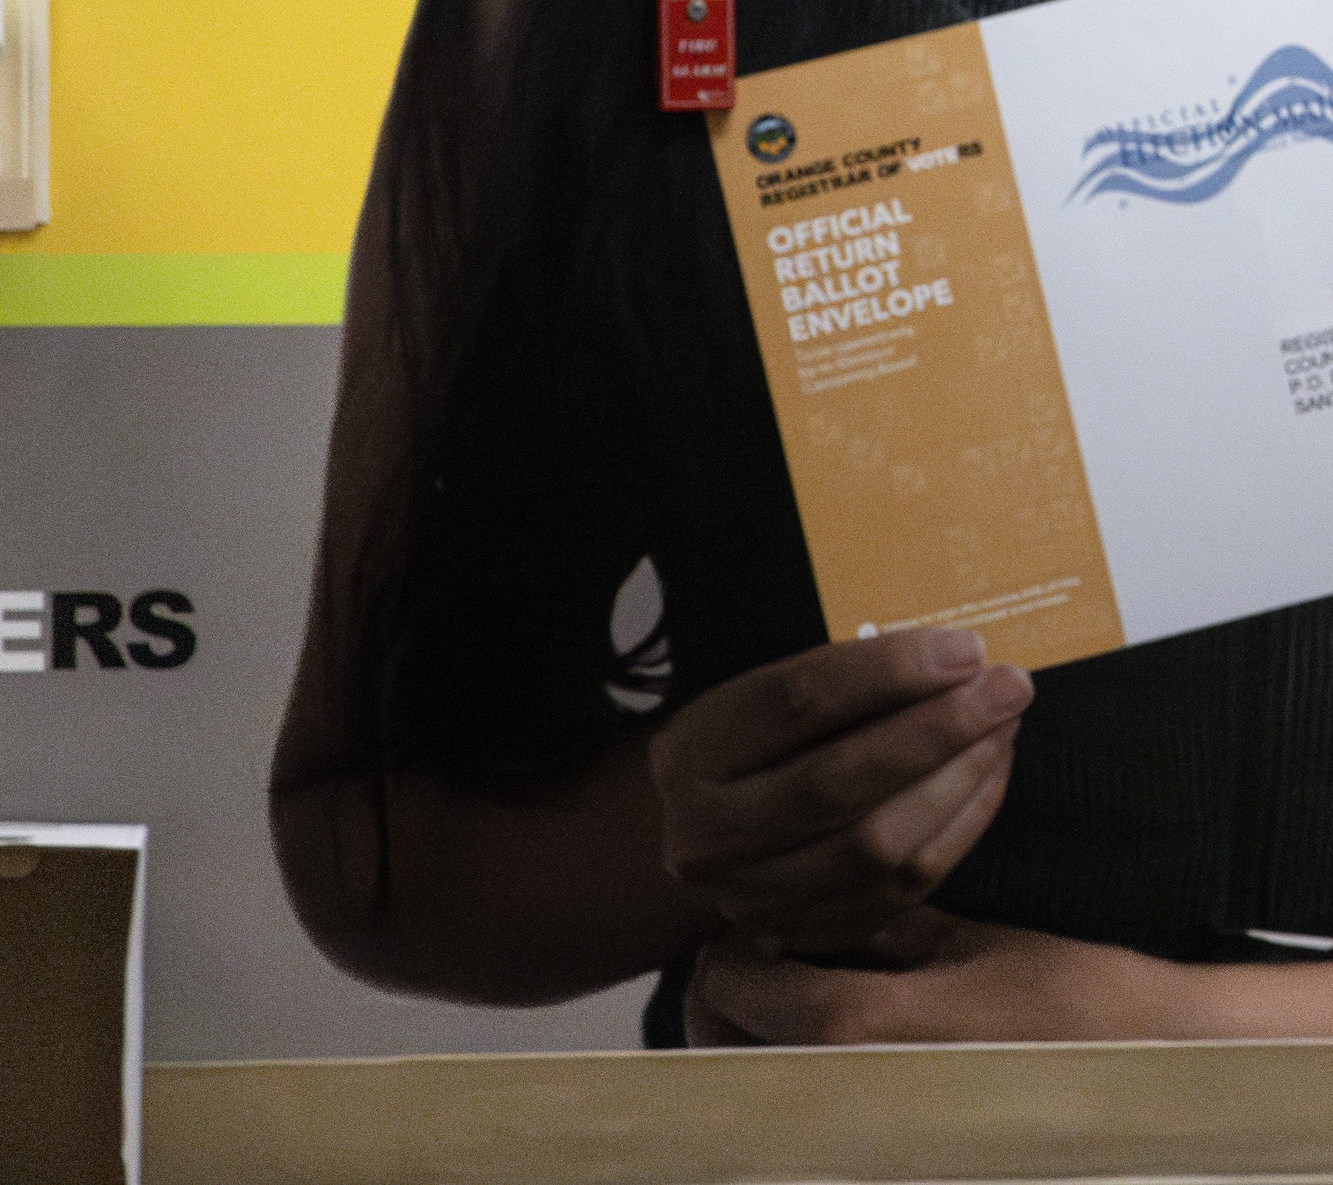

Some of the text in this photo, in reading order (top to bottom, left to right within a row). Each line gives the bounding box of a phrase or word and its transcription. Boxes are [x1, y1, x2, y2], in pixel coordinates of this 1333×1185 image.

[842, 136, 921, 168] COUNTY
[760, 168, 871, 207] REGISTRAR
[767, 197, 914, 253] OFFICIAL
[774, 230, 900, 284] RETURN
[781, 260, 899, 313] BALLOT
[787, 278, 953, 342] ENVELOPE
